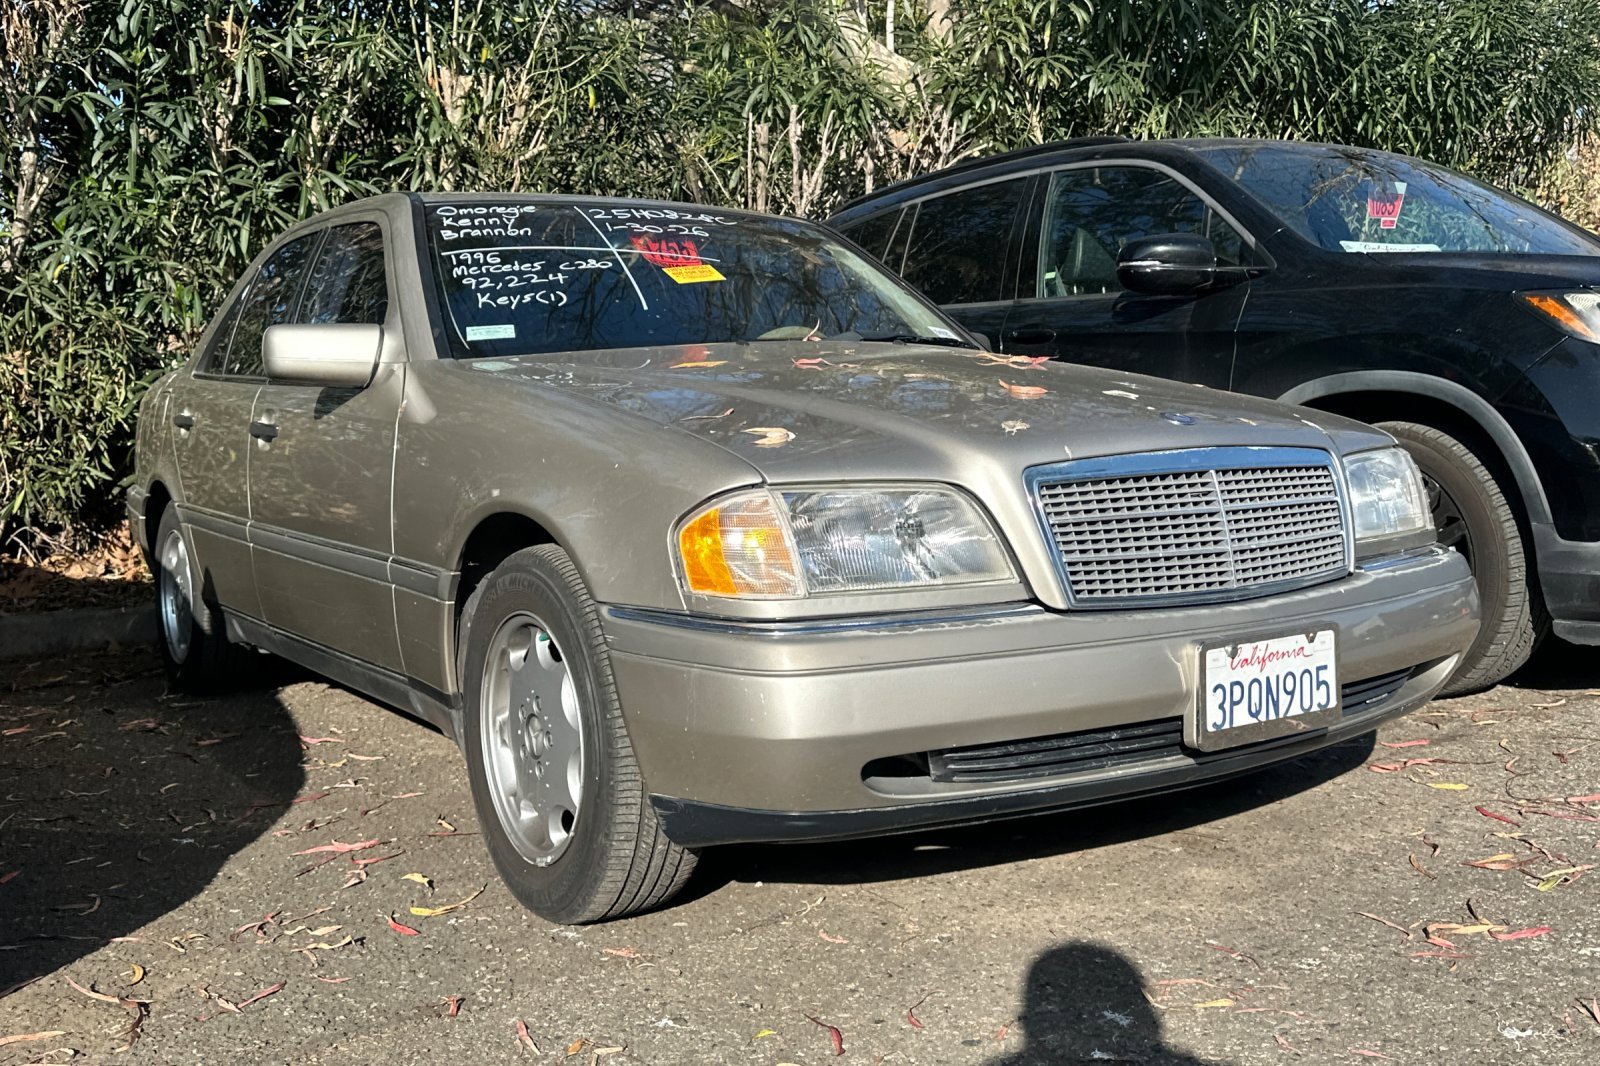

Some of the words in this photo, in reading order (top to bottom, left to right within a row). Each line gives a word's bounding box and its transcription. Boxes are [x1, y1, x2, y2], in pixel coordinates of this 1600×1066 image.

[436, 205, 536, 218] Omoregie
[442, 216, 515, 231] Kenny
[605, 221, 710, 237] 1-30-26
[440, 227, 531, 240] Brannon
[450, 251, 502, 266] 1996
[452, 261, 546, 277] Mercedes
[461, 272, 569, 290] 92,224
[477, 291, 567, 309] Keys(1)
[1229, 643, 1314, 673] California
[1211, 664, 1331, 731] 3PQN905
